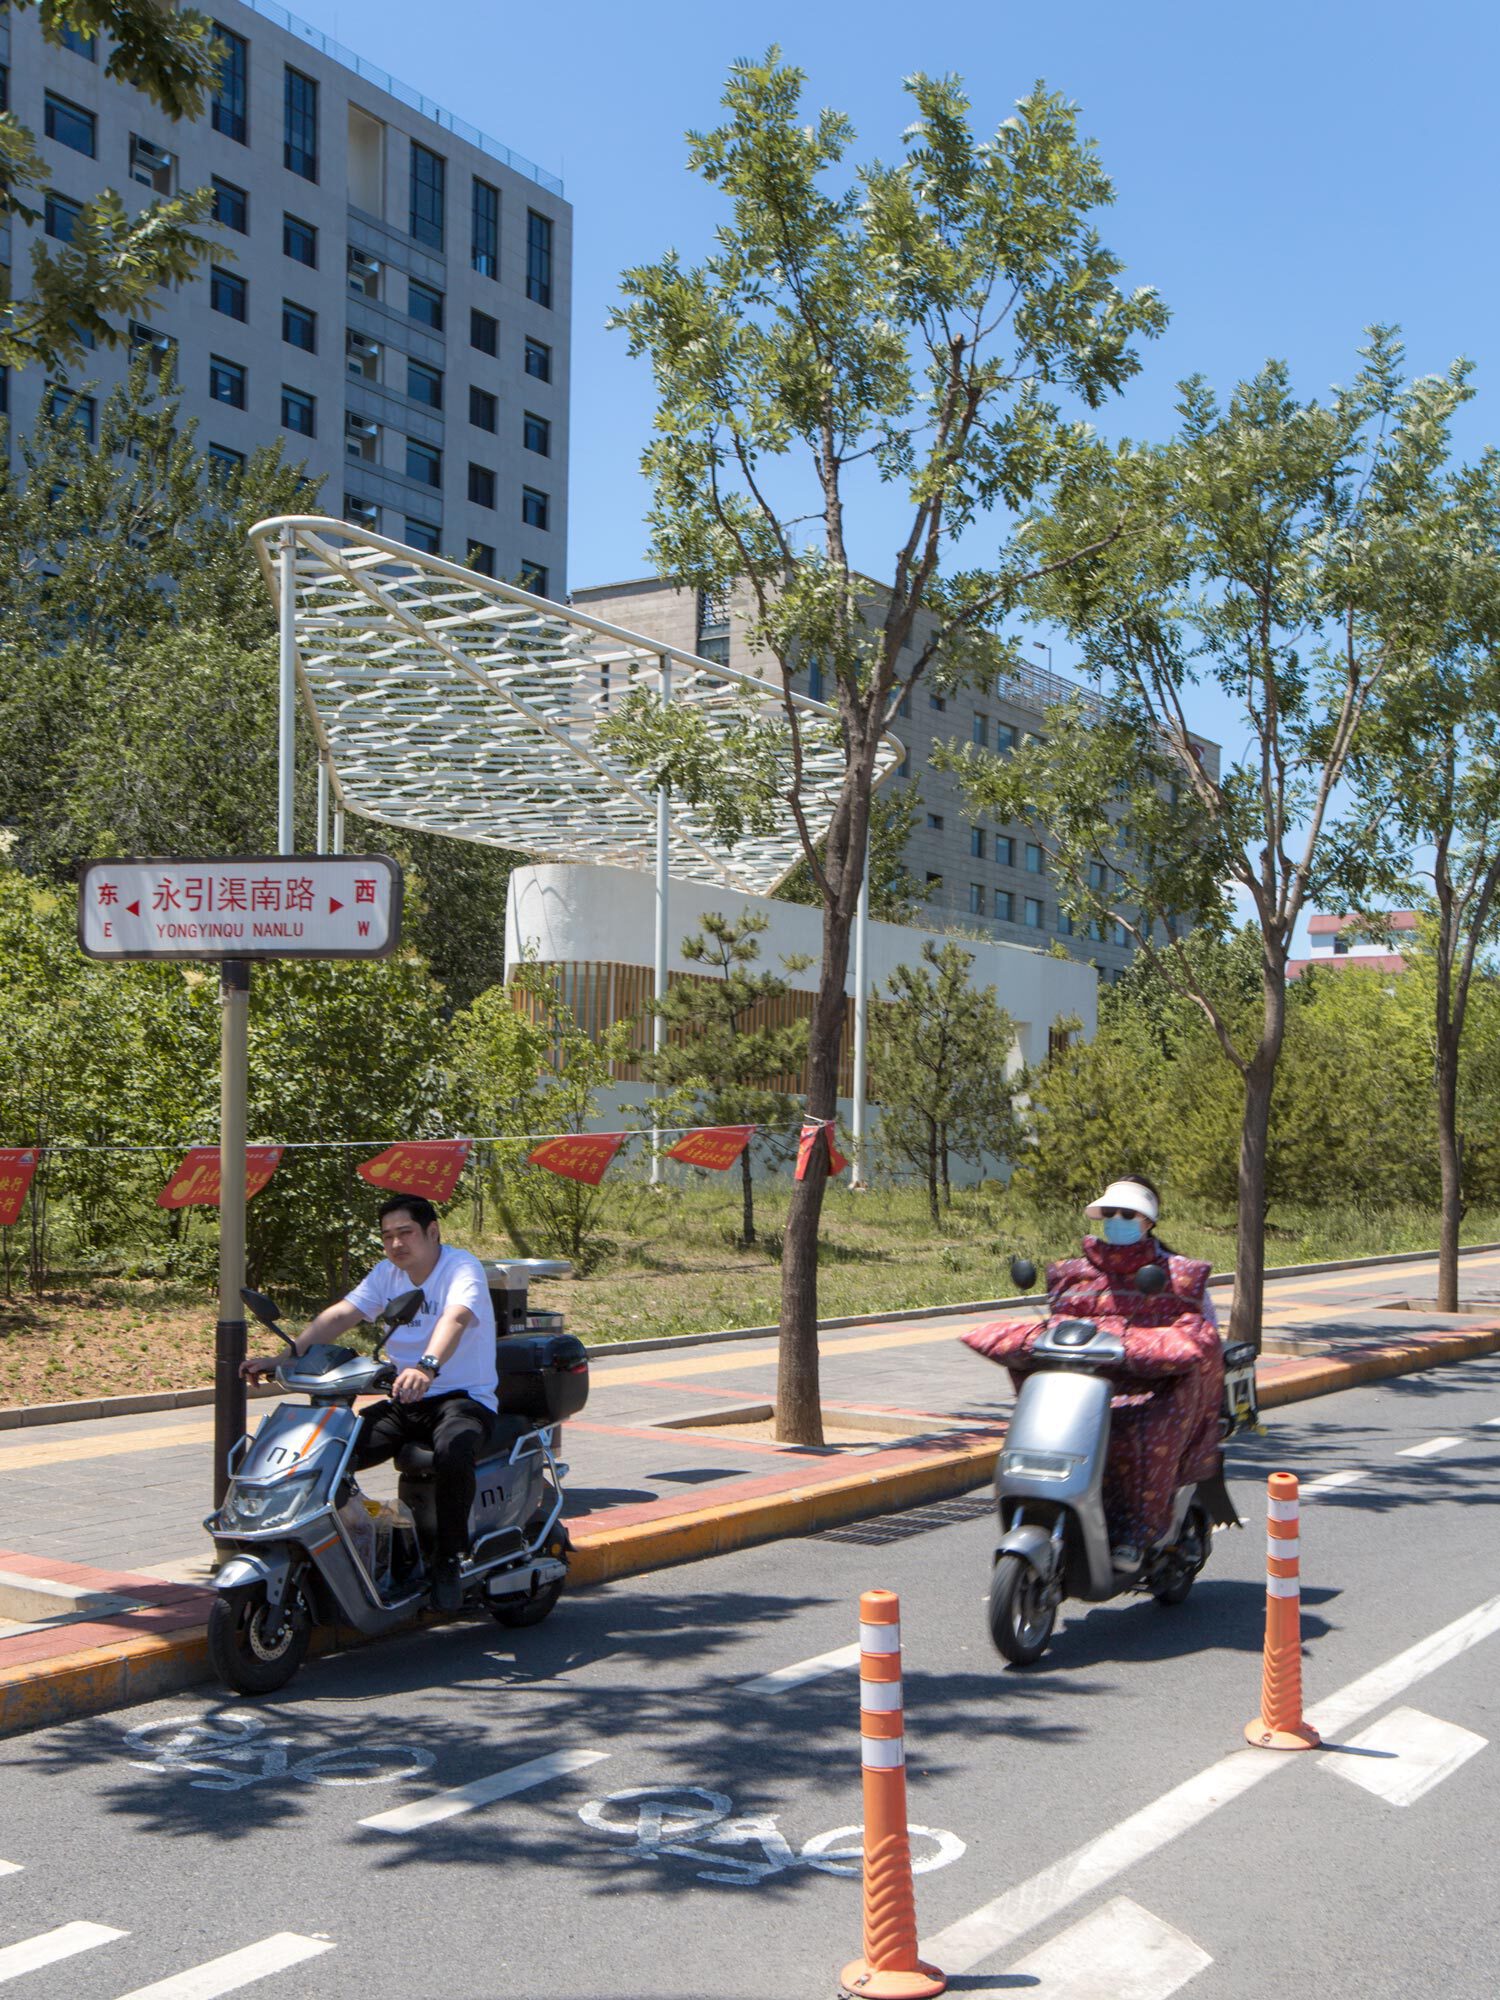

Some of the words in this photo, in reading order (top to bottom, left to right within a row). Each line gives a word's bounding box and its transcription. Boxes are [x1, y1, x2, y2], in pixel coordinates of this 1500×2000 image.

[97, 882, 119, 906] 东
[152, 876, 315, 912] 永引渠南路
[354, 879, 377, 904] 西
[103, 921, 113, 938] E
[156, 923, 244, 939] YONGYINQU
[252, 922, 304, 938] NANLU
[357, 920, 371, 937] W
